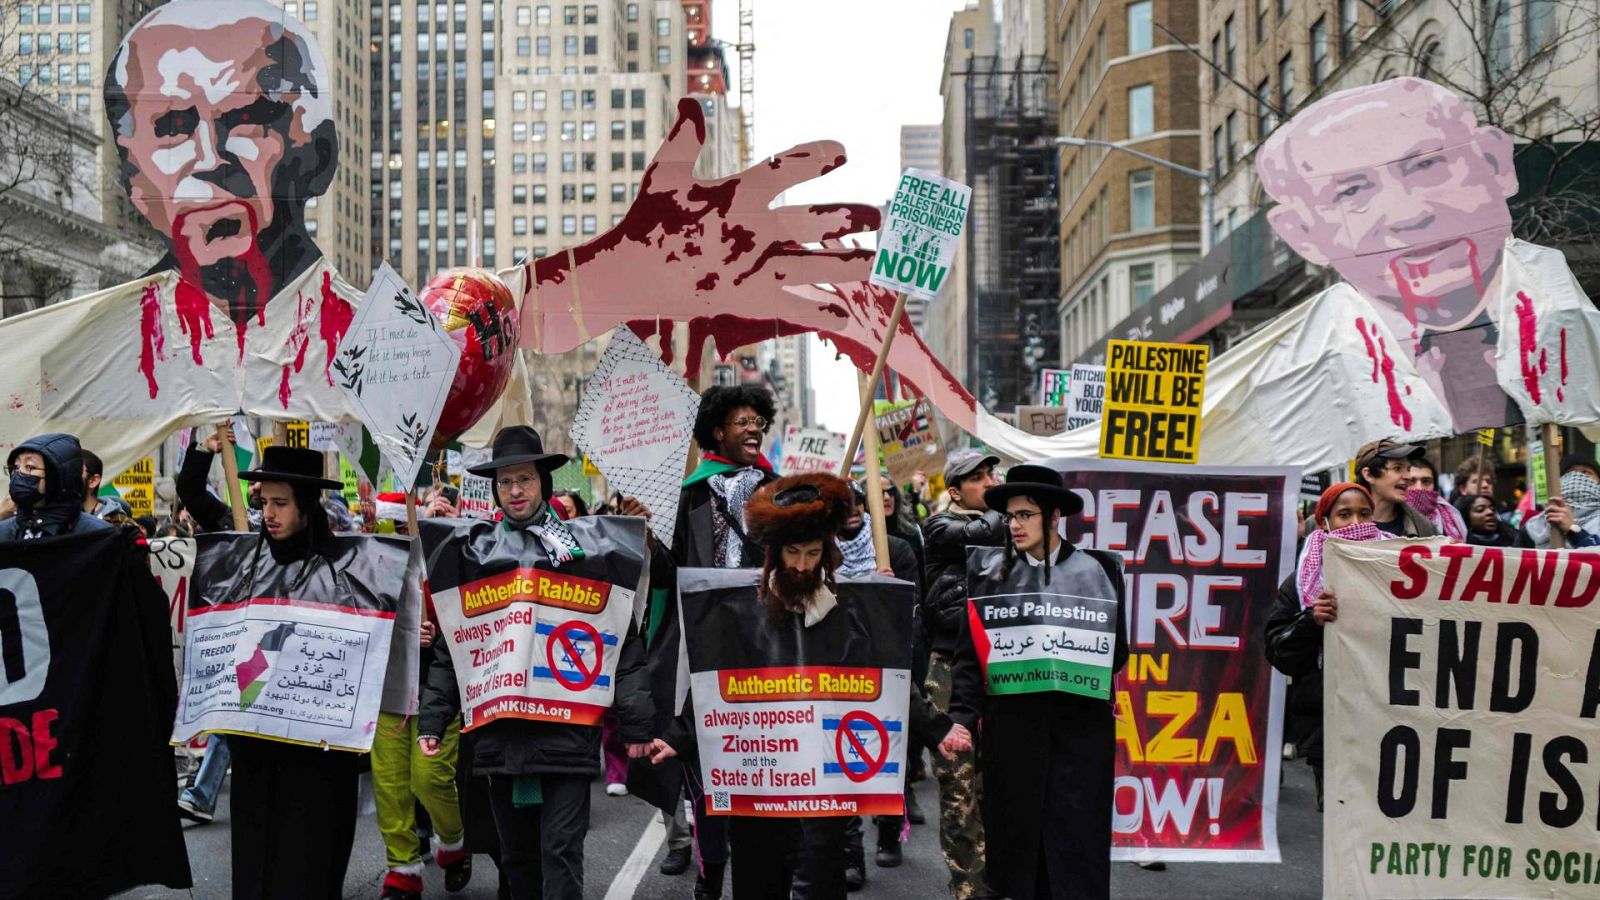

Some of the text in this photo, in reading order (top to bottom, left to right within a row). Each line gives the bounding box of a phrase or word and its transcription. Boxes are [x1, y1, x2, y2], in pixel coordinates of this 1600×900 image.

[899, 175, 966, 211] FREE ALL
[890, 203, 962, 236] PRISONERS
[895, 191, 965, 223] PALESTINIAN
[875, 248, 947, 292] NOW
[1111, 344, 1205, 374] PALESTINE
[1083, 384, 1104, 398] BLO
[1111, 372, 1201, 408] WILL BE
[875, 402, 930, 429] PALESTNA
[1076, 397, 1102, 413] YOUR
[1030, 413, 1066, 431] FRE
[1105, 409, 1197, 459] FREE!
[799, 436, 829, 455] FREE
[114, 474, 152, 485] ALESTINIAN
[1059, 487, 1268, 567] CEASE
[149, 539, 188, 569] RS
[1390, 545, 1600, 607] STAND
[538, 576, 602, 607] Rabbis
[454, 607, 532, 643] always opsed
[984, 602, 1108, 623] Free Palestine
[1125, 573, 1243, 650] RE
[300, 642, 346, 661] الحرية
[994, 629, 1110, 657] فلسطين عربية
[205, 663, 225, 675] GAZA
[291, 664, 299, 672] و
[303, 663, 324, 675] غزة
[1128, 652, 1170, 685] IN
[1389, 617, 1539, 713] END
[189, 685, 203, 696] ALL
[277, 676, 355, 697] كل فلسطين
[492, 670, 527, 692] Israel
[727, 672, 875, 696] Authentic Rabbis
[992, 668, 1100, 691] www.nkusa.org
[482, 701, 572, 720] www.NKUSA.org
[704, 705, 815, 730] always opposed
[1114, 691, 1258, 766] AZA
[0, 708, 63, 780] DE
[722, 734, 799, 753] Zionism
[742, 755, 777, 767] and the
[711, 767, 816, 788] State of Israel
[1377, 725, 1600, 831] OF IS
[753, 799, 858, 812] www.NKUSA.org
[1112, 775, 1225, 836] OW!
[1370, 842, 1451, 879] PARTY
[1464, 845, 1512, 878] FOR
